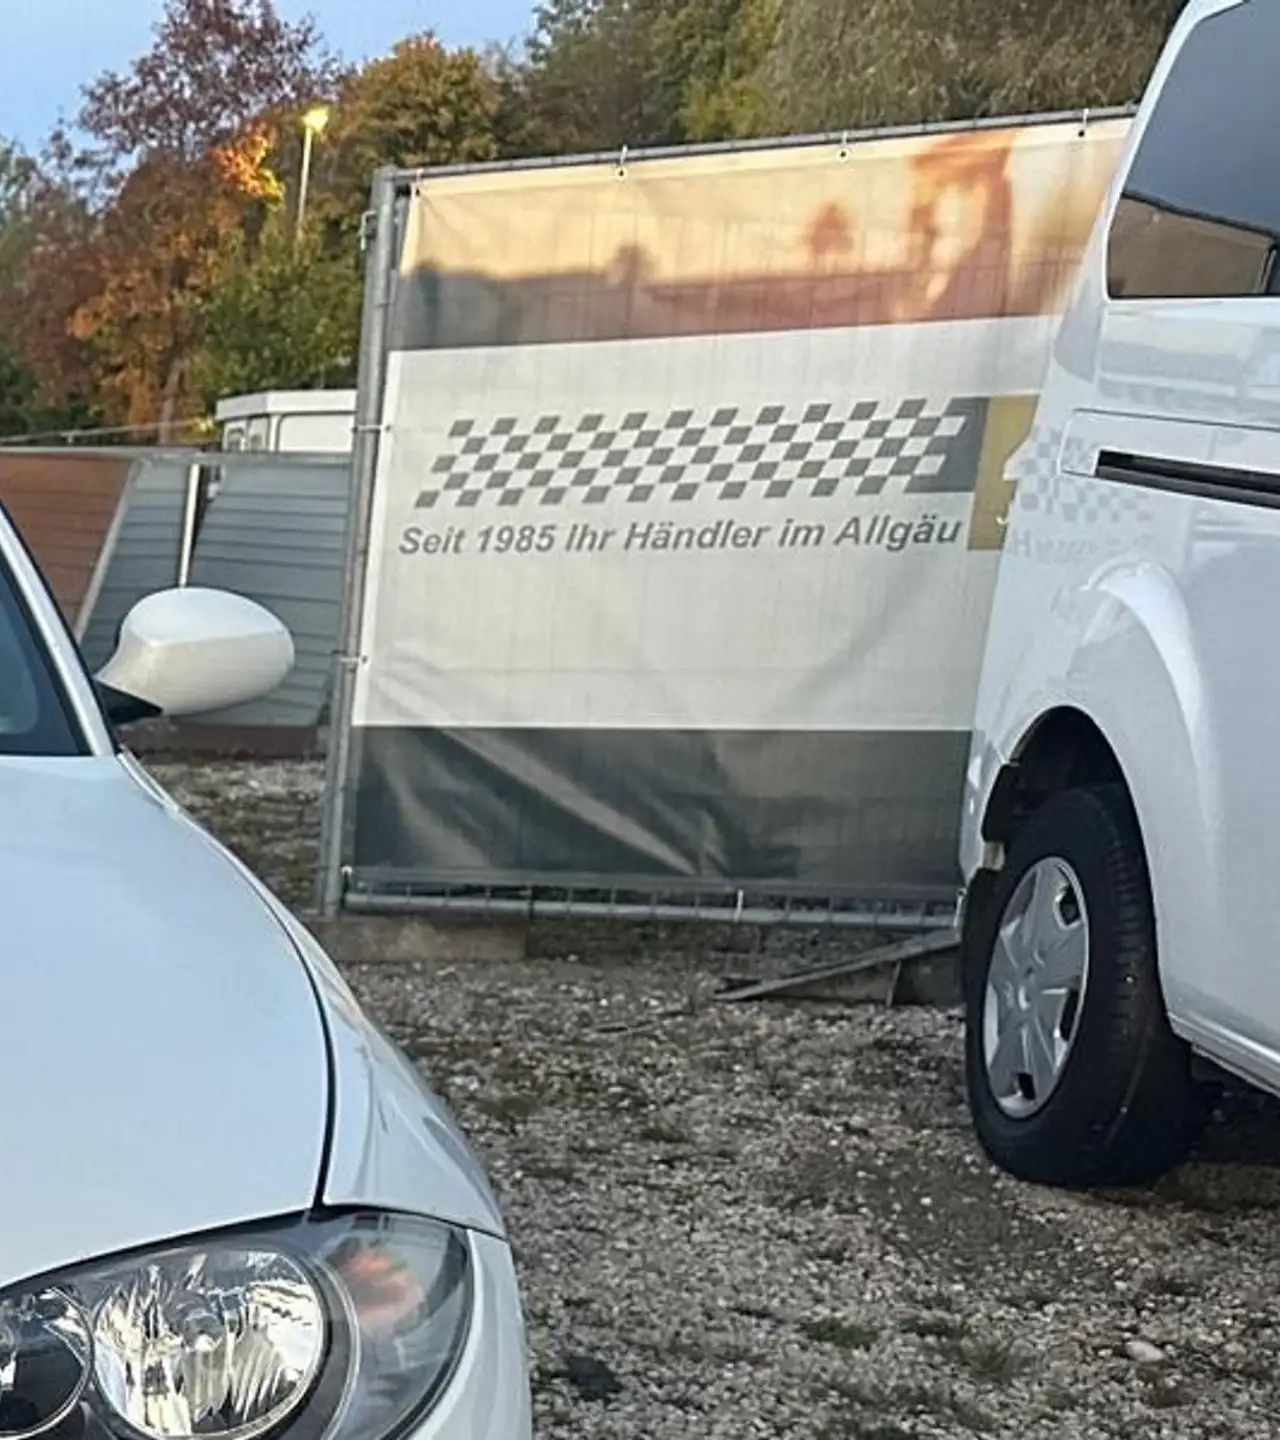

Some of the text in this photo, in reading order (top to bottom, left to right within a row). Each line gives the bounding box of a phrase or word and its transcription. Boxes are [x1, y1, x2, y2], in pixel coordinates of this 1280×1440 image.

[398, 513, 963, 554] Seit 1985 Ihr Händler im Allgäu
